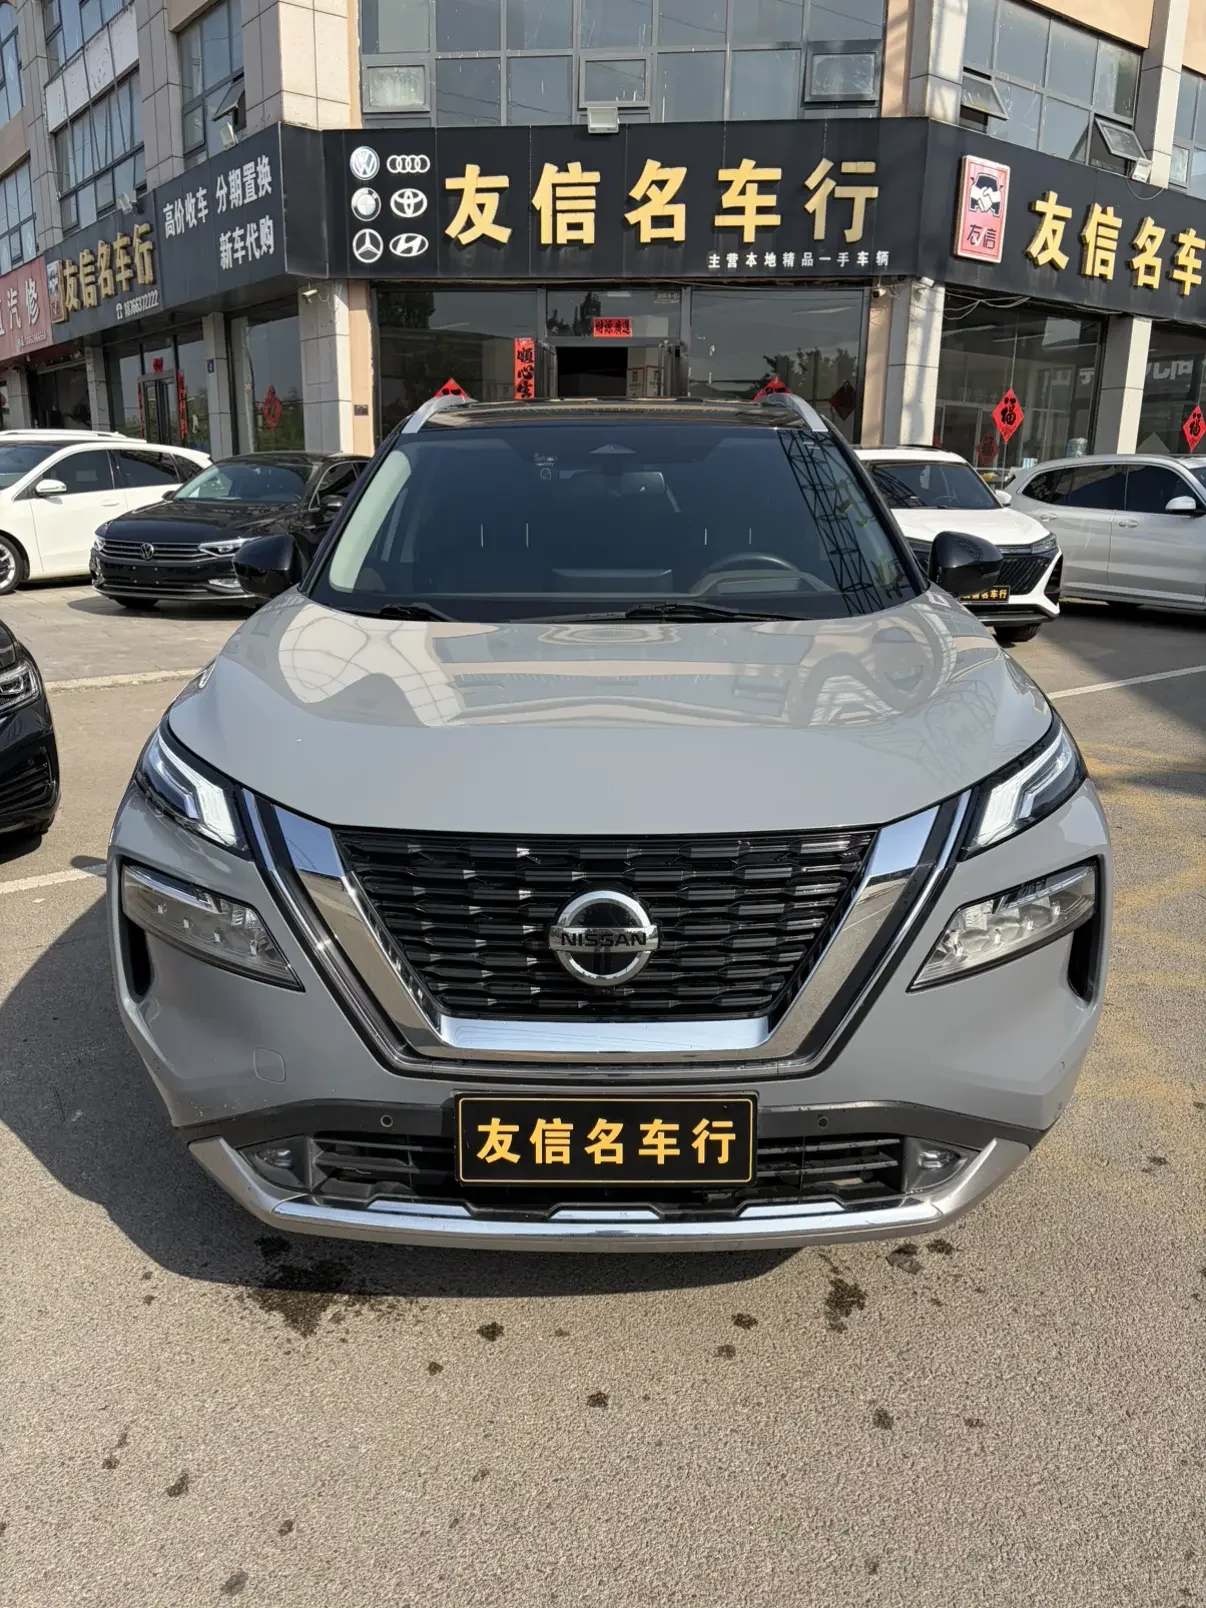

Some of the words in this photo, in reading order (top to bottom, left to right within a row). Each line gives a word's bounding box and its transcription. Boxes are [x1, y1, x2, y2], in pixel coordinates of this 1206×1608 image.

[163, 187, 208, 238] 高价收车
[216, 155, 272, 214] 分期置换
[444, 158, 878, 246] 友信名车行
[219, 215, 274, 269] 新车代购
[708, 250, 890, 268] 主营本地精品一手车辆
[967, 224, 997, 250] 友信
[1025, 190, 1206, 296] 友信名车
[63, 223, 154, 312] 友信名车行
[561, 932, 647, 947] NISSAN
[476, 1117, 736, 1165] 友信名车行
